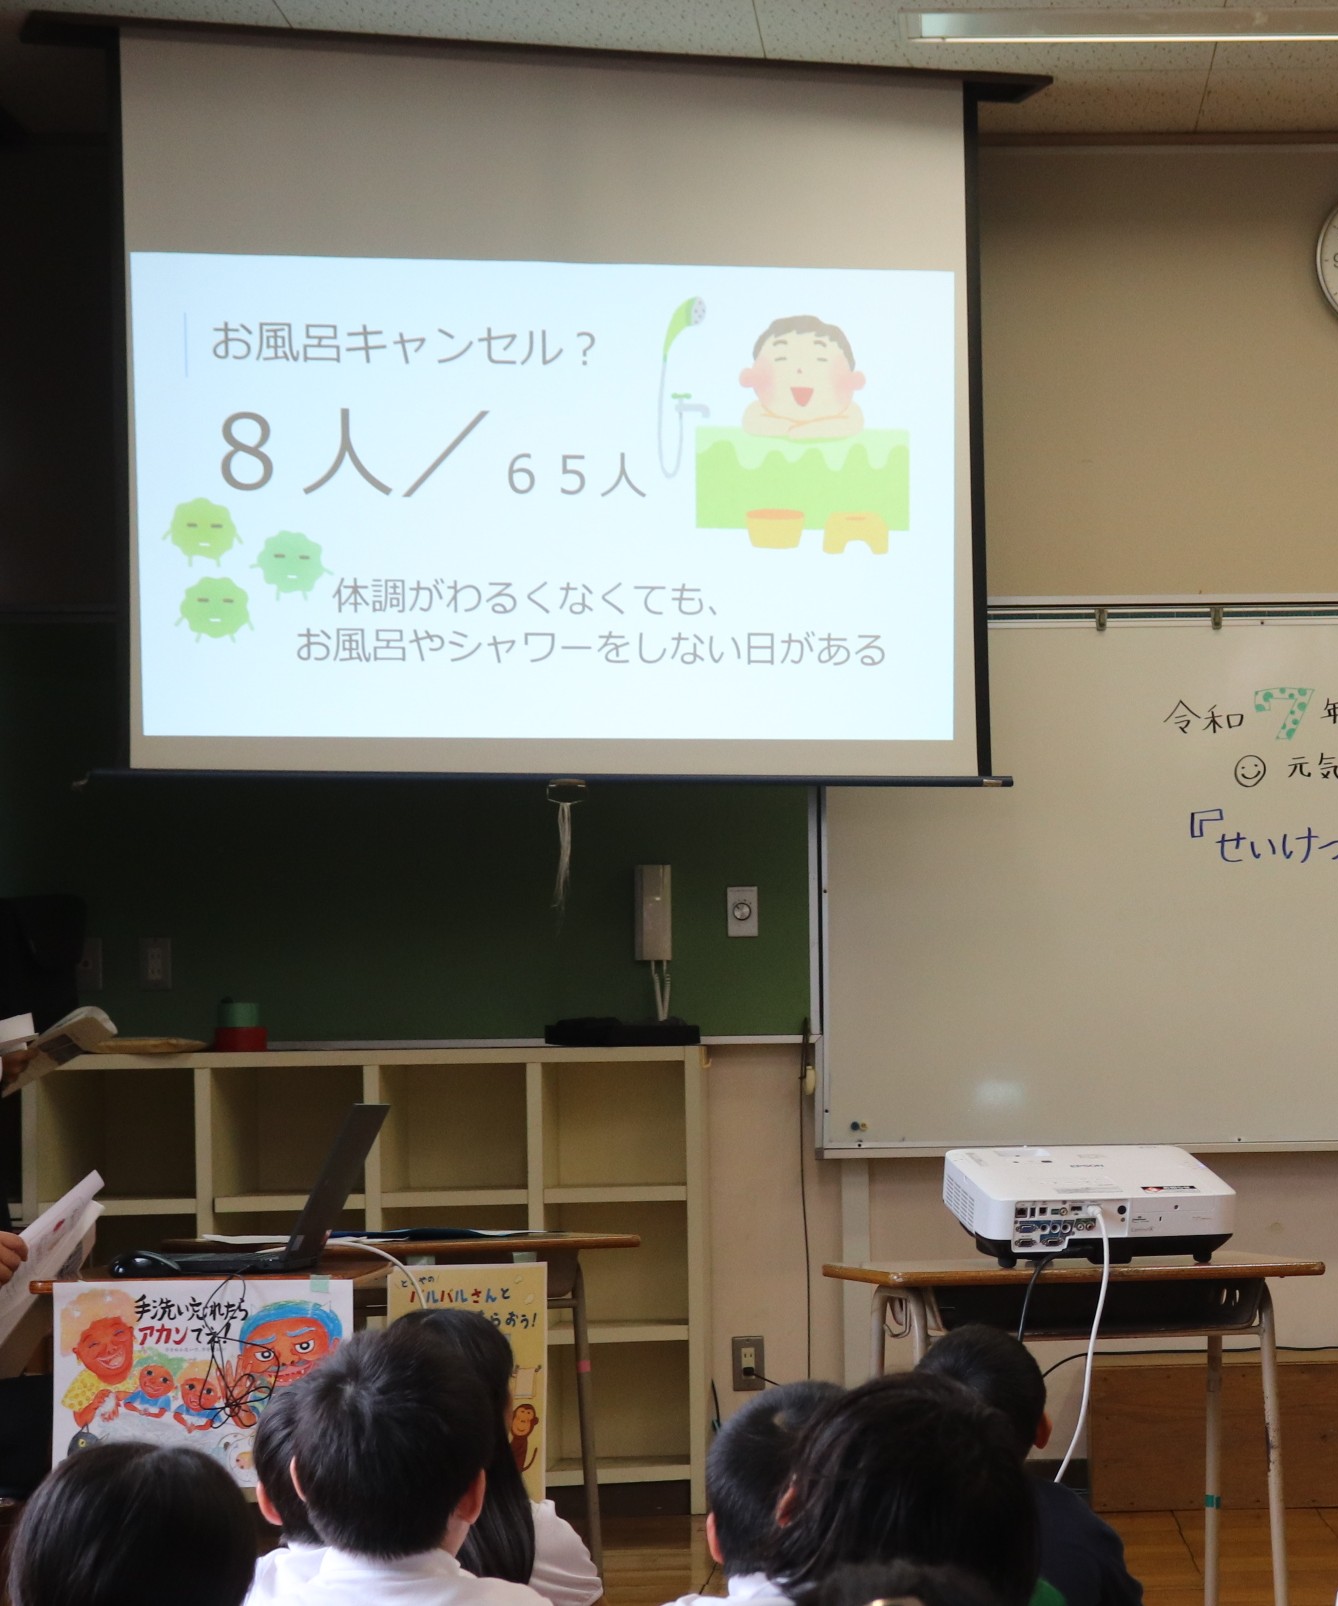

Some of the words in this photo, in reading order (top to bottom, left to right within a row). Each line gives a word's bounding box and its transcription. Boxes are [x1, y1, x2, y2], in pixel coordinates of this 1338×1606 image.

[211, 321, 596, 366] お風呂キャンセル？
[332, 577, 718, 617] 体調がわるくなくても、
[296, 627, 886, 667] お風呂やシャワーをしない日がある
[401, 1275, 435, 1288] とやの
[134, 1294, 249, 1322] 手洗い忘れたら
